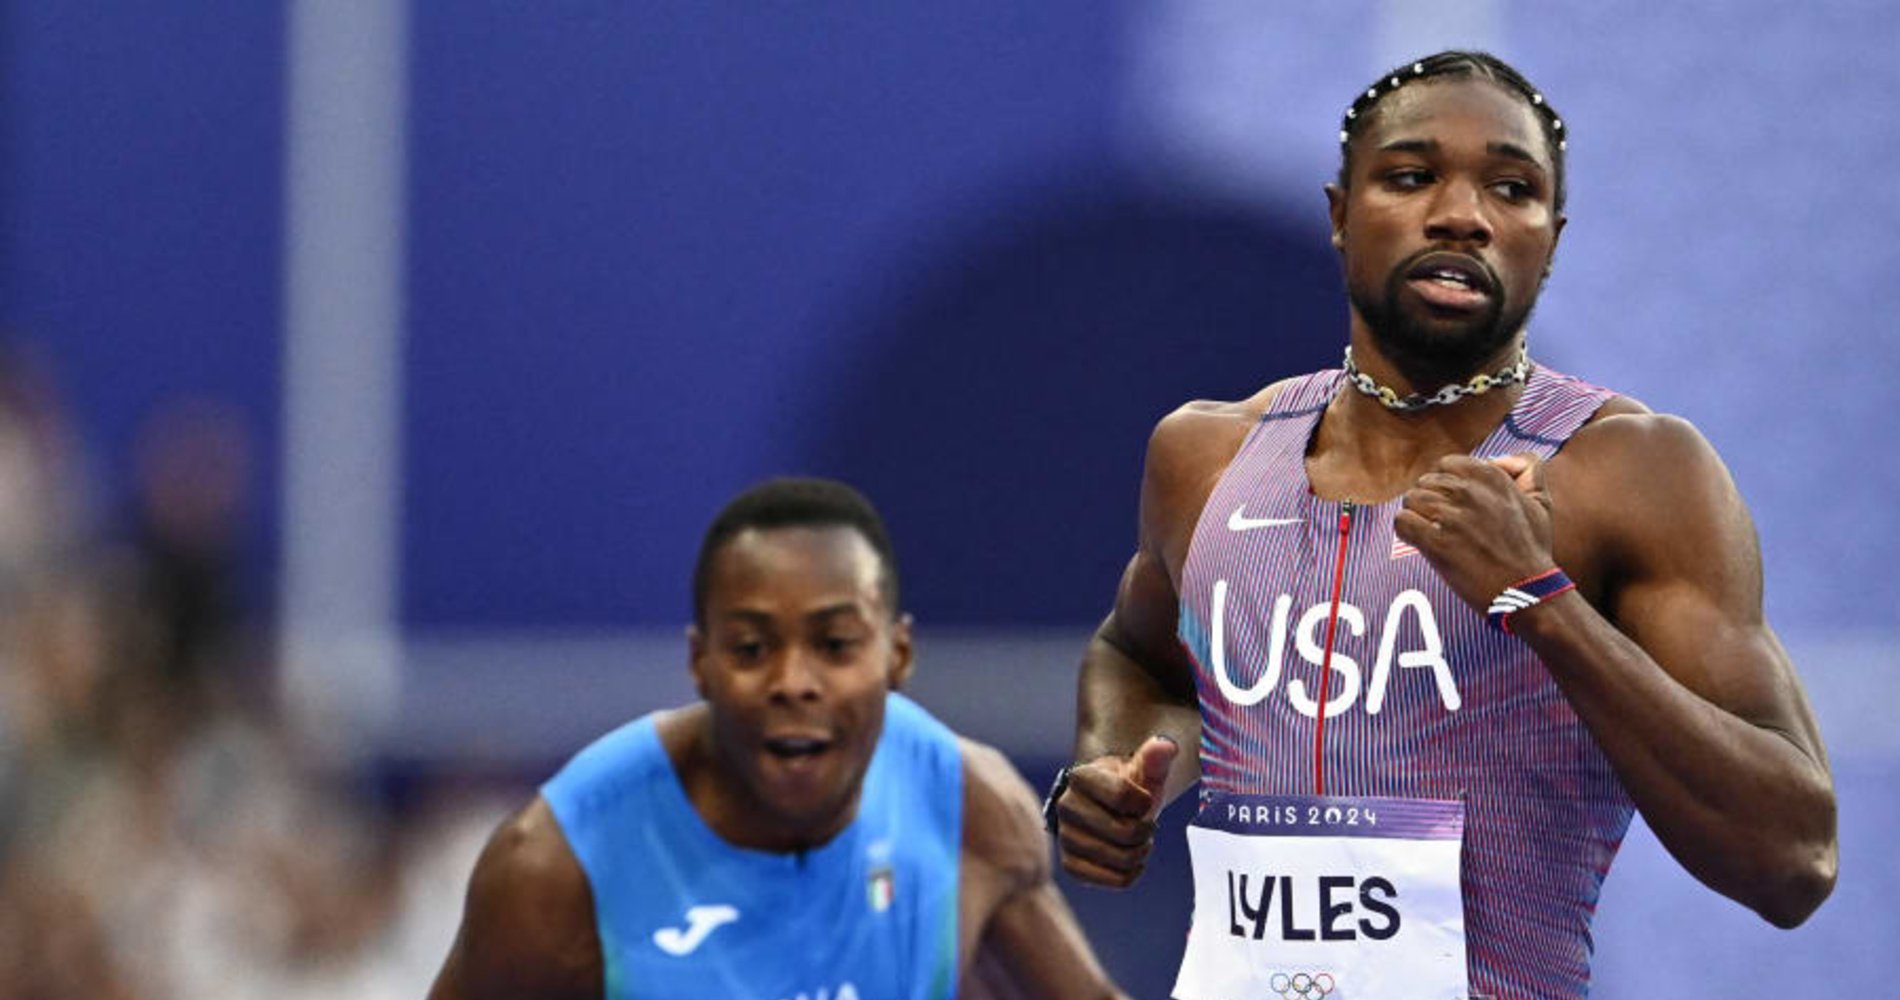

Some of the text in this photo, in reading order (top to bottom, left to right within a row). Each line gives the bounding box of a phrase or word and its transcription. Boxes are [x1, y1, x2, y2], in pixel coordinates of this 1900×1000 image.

[1210, 579, 1461, 717] USA
[1308, 808, 1376, 826] 2024
[1228, 869, 1400, 941] LYLES
